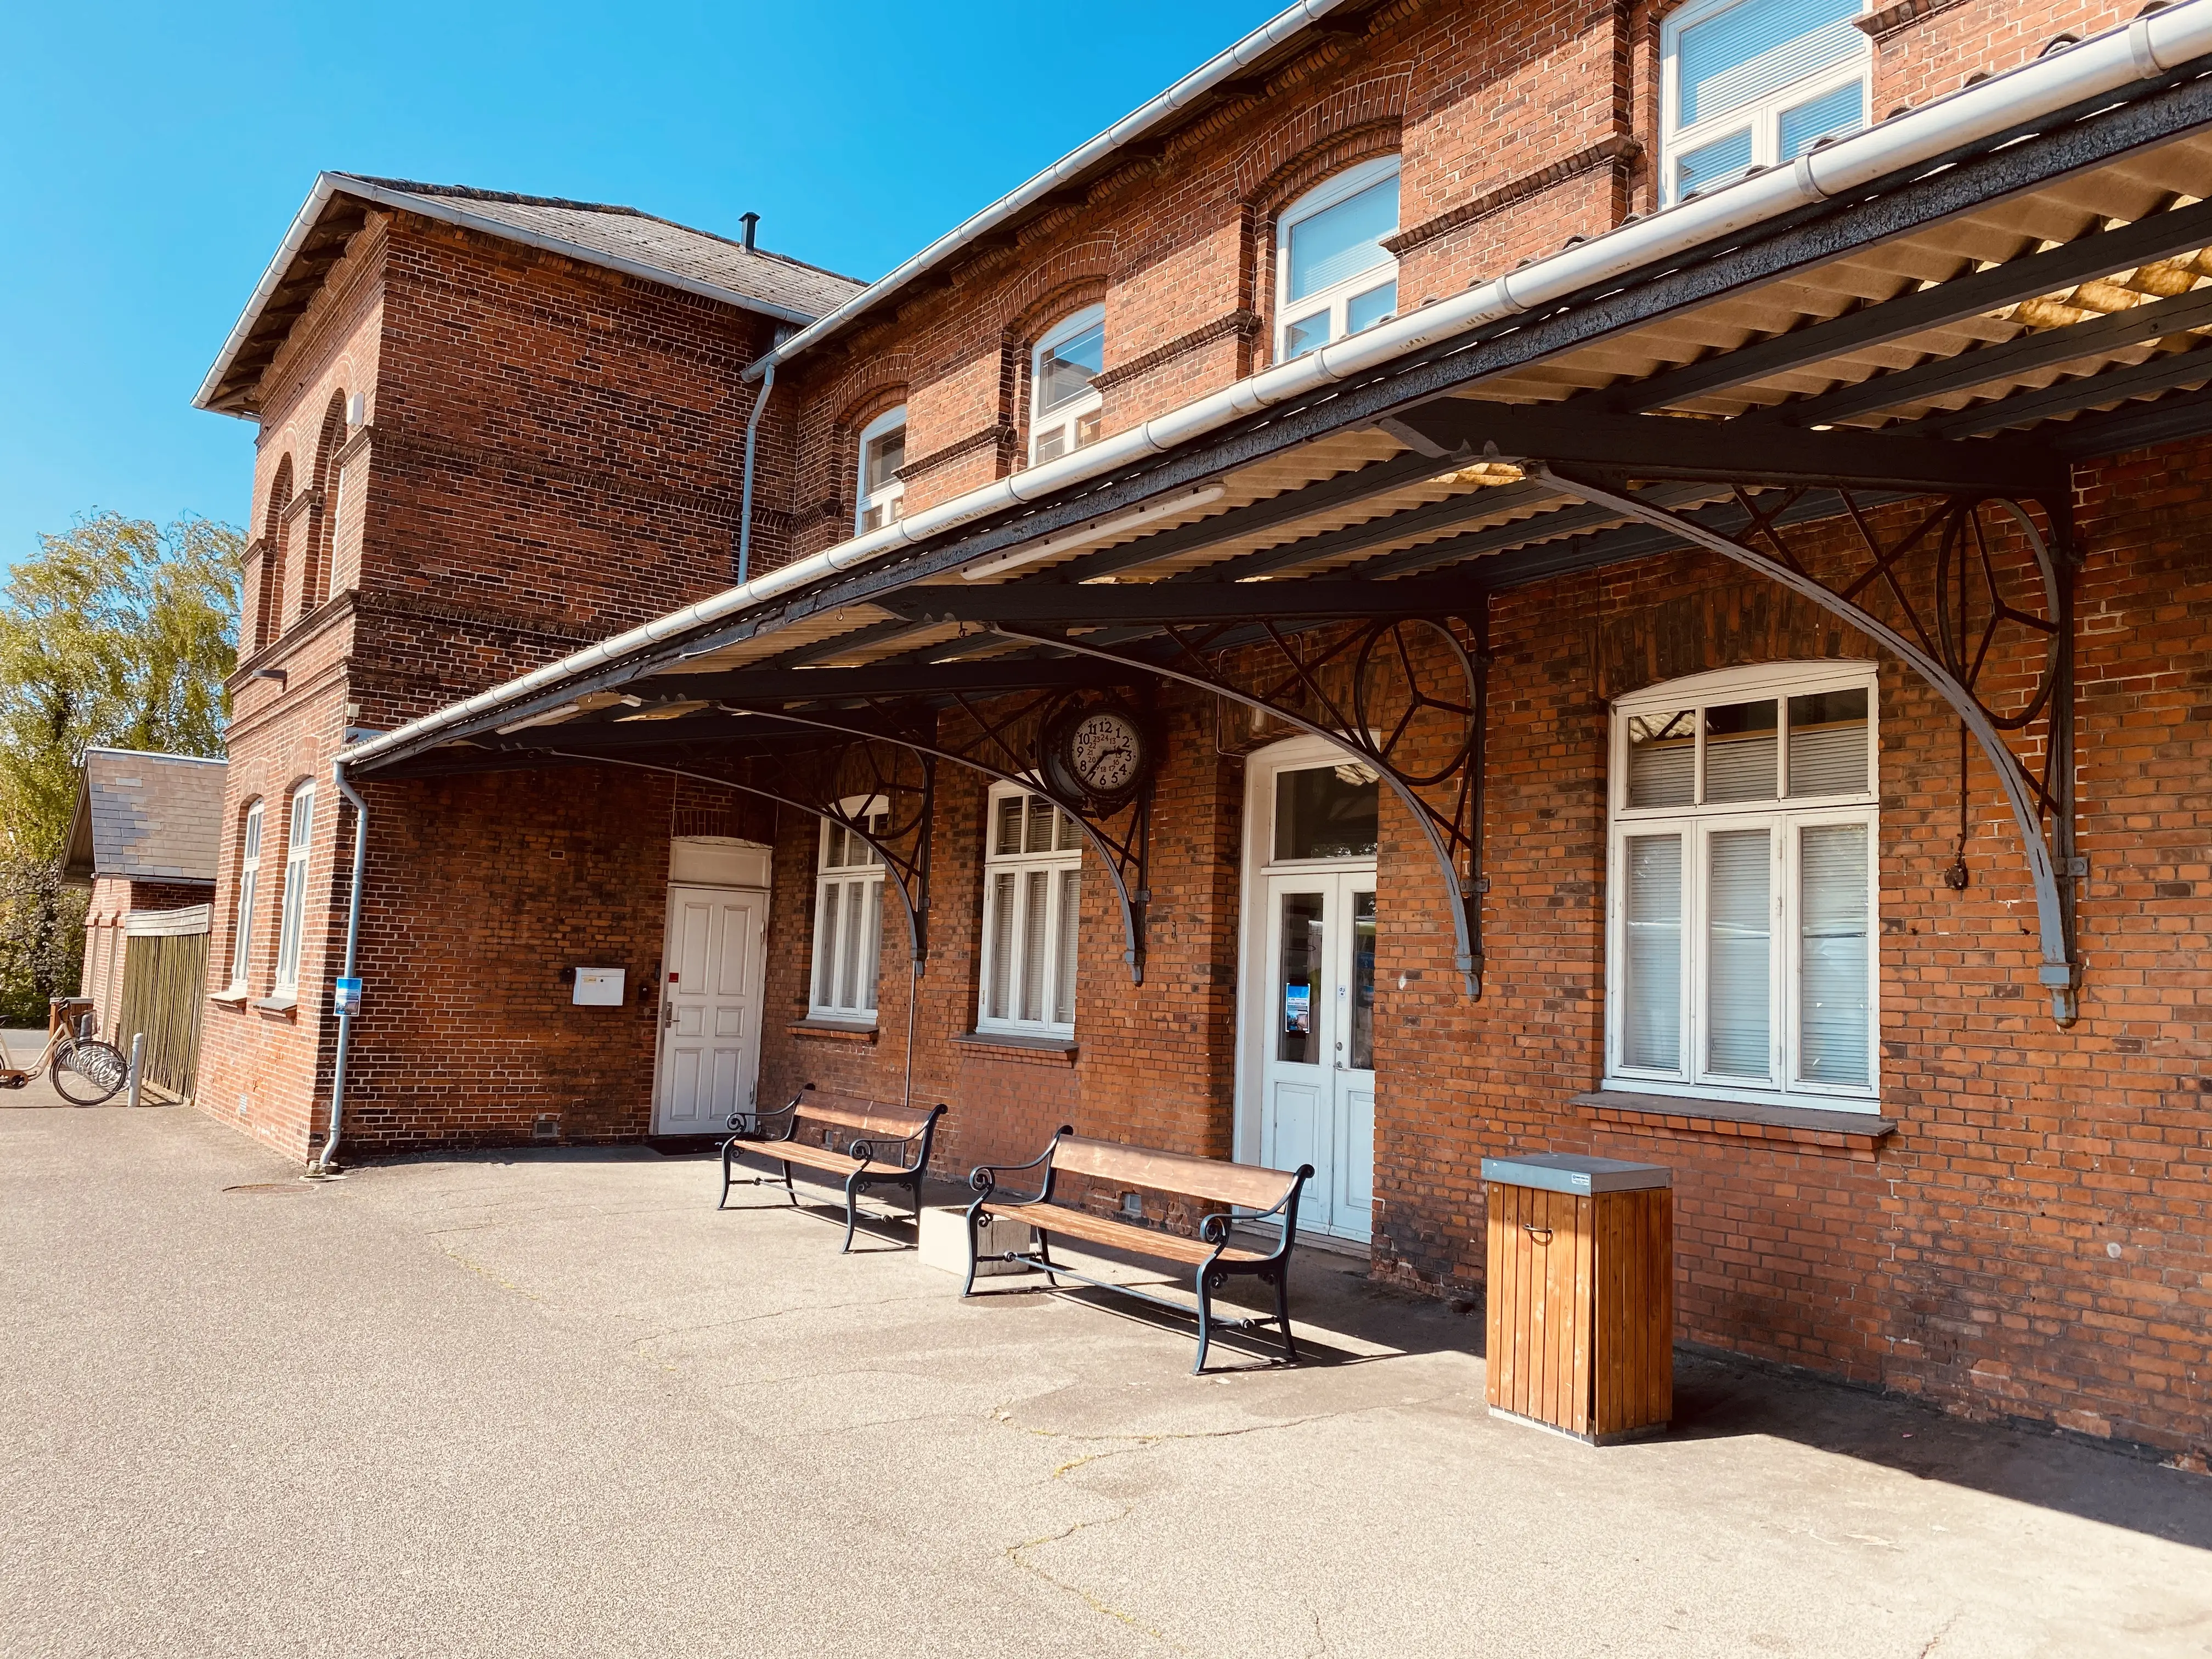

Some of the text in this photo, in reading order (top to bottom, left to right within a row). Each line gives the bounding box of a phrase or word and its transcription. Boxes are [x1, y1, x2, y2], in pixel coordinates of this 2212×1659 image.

[1088, 723, 1097, 735] 11
[1099, 721, 1113, 733] 12
[1115, 727, 1120, 738] 1
[1078, 733, 1090, 745] 10
[1122, 736, 1130, 747] 2
[1076, 746, 1084, 758] 9
[1125, 751, 1132, 761] 3
[1080, 760, 1087, 771] 8
[1119, 763, 1127, 775] 4
[1099, 774, 1107, 786] 6
[1111, 771, 1119, 783] 5
